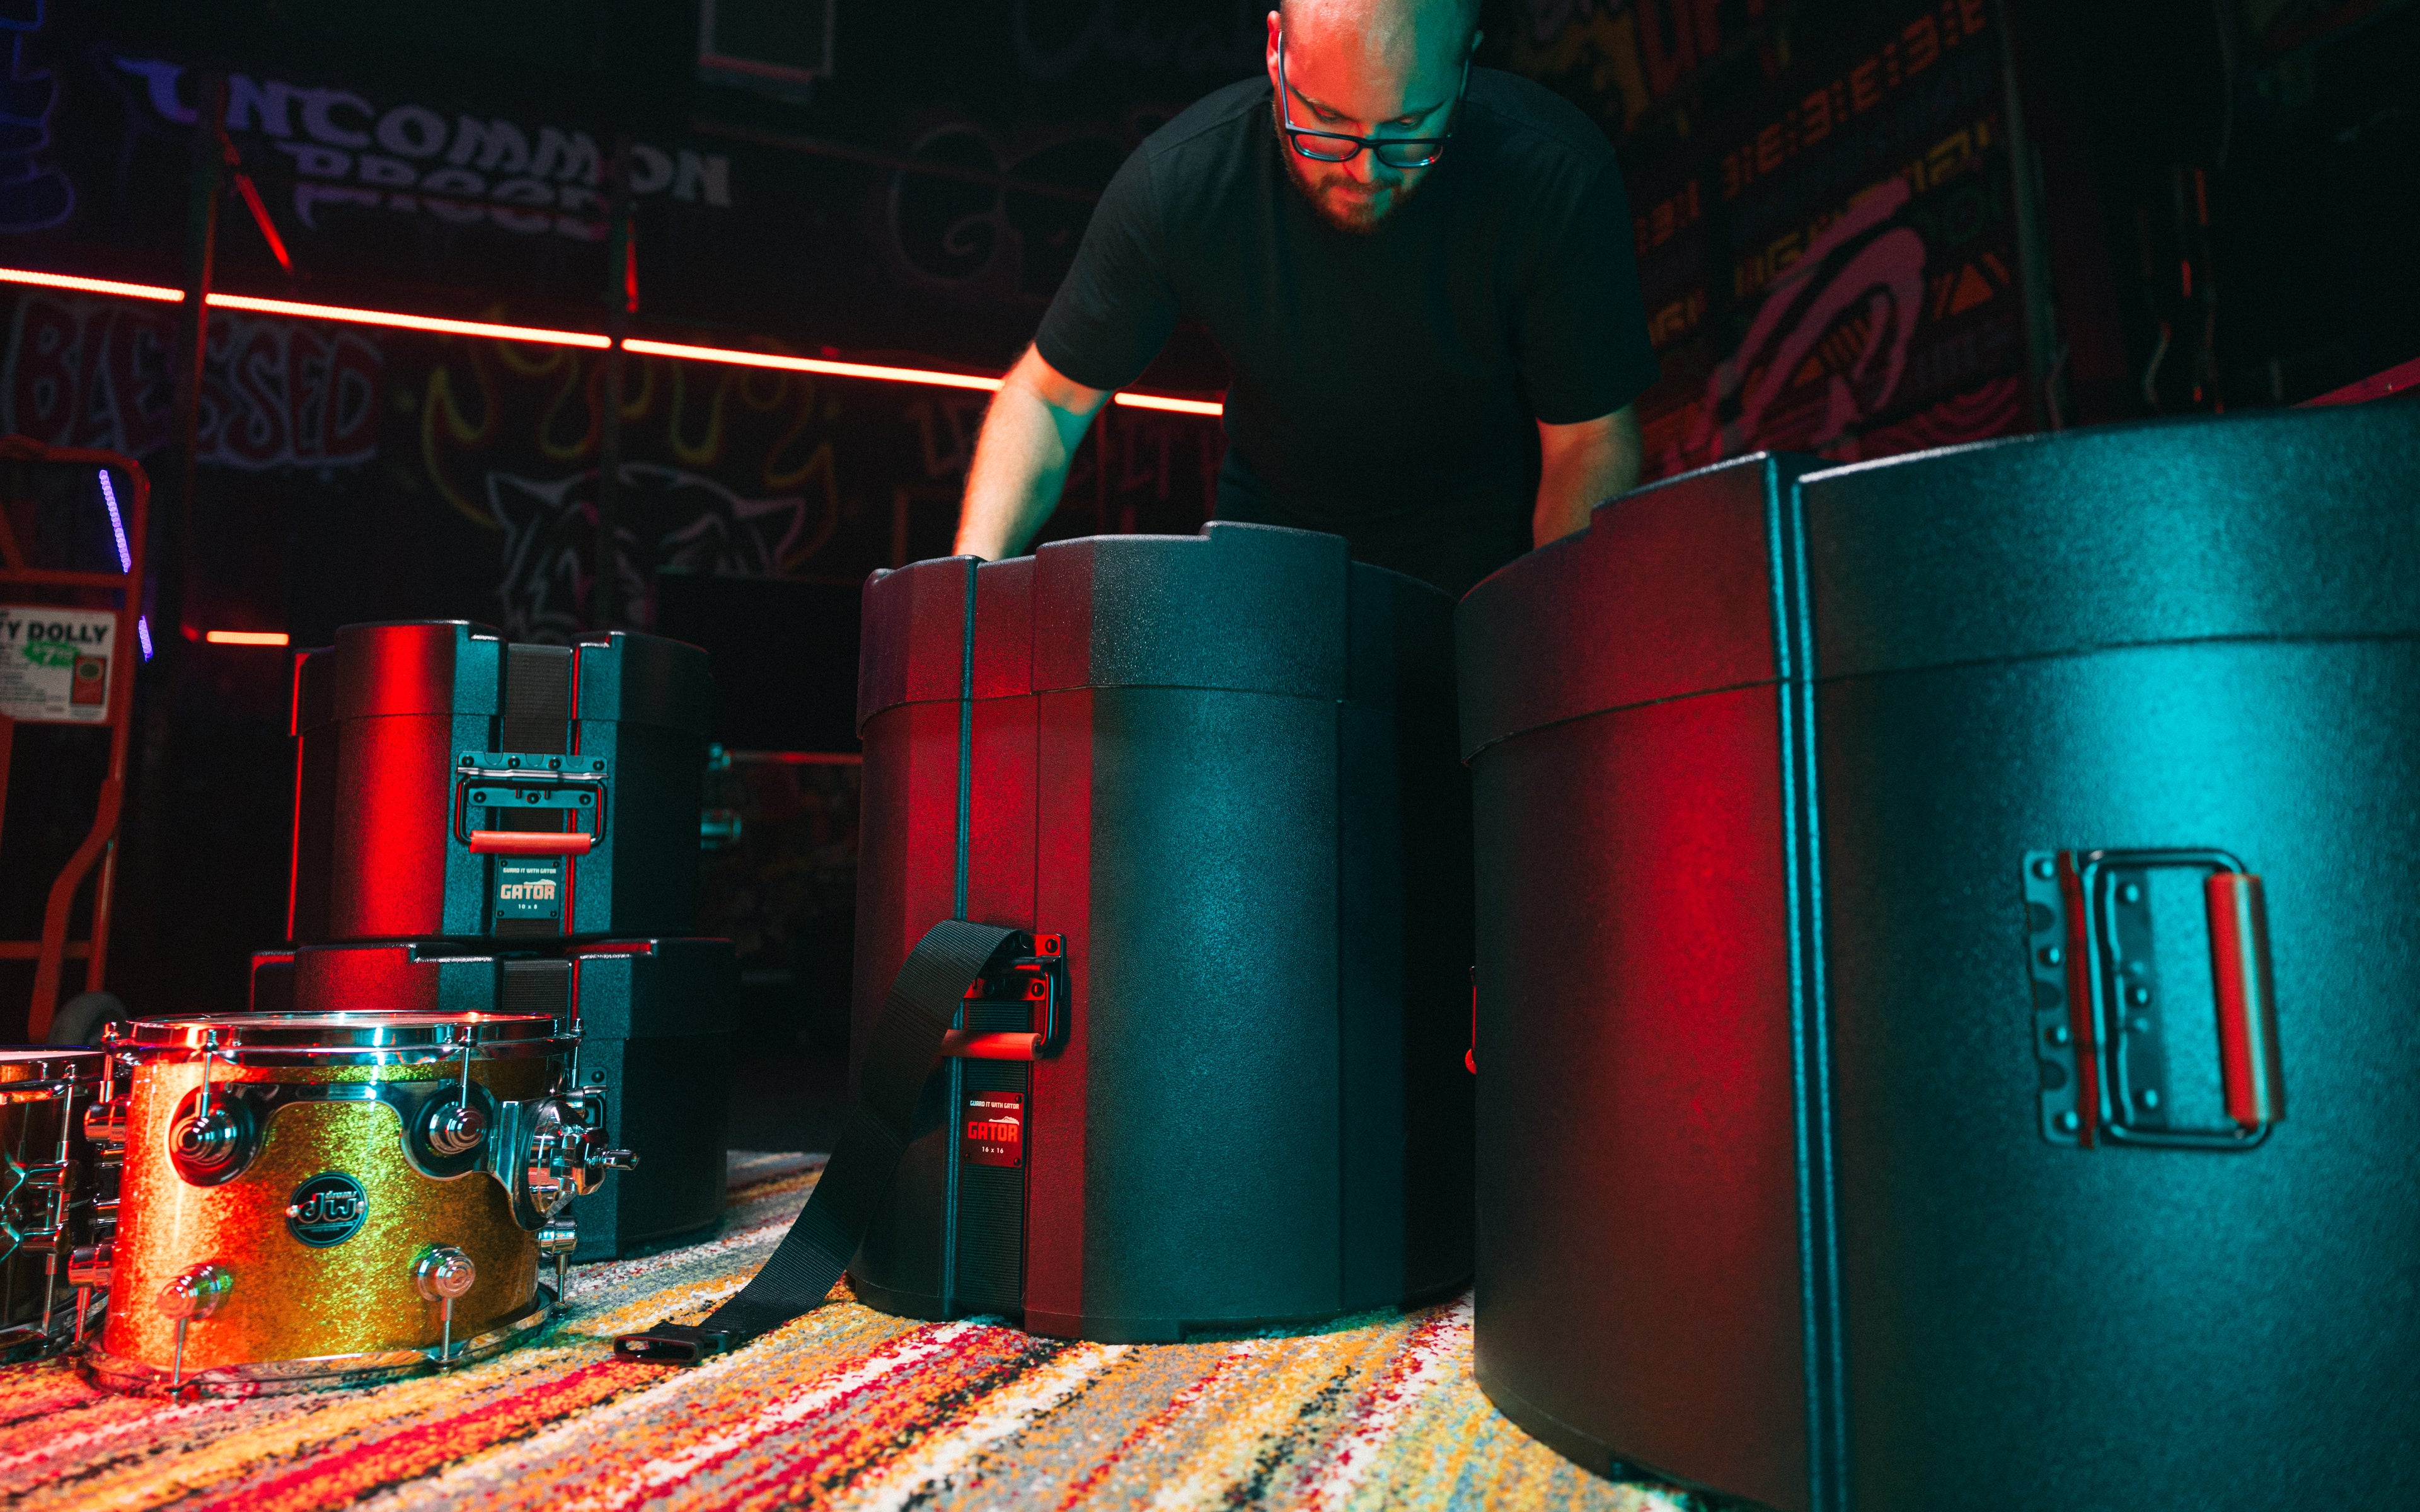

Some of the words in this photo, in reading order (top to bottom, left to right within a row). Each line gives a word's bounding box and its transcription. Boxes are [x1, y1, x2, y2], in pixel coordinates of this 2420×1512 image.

[28, 621, 108, 643] DOLLY
[500, 885, 555, 900] GATOR
[967, 1121, 1018, 1143] GATOR
